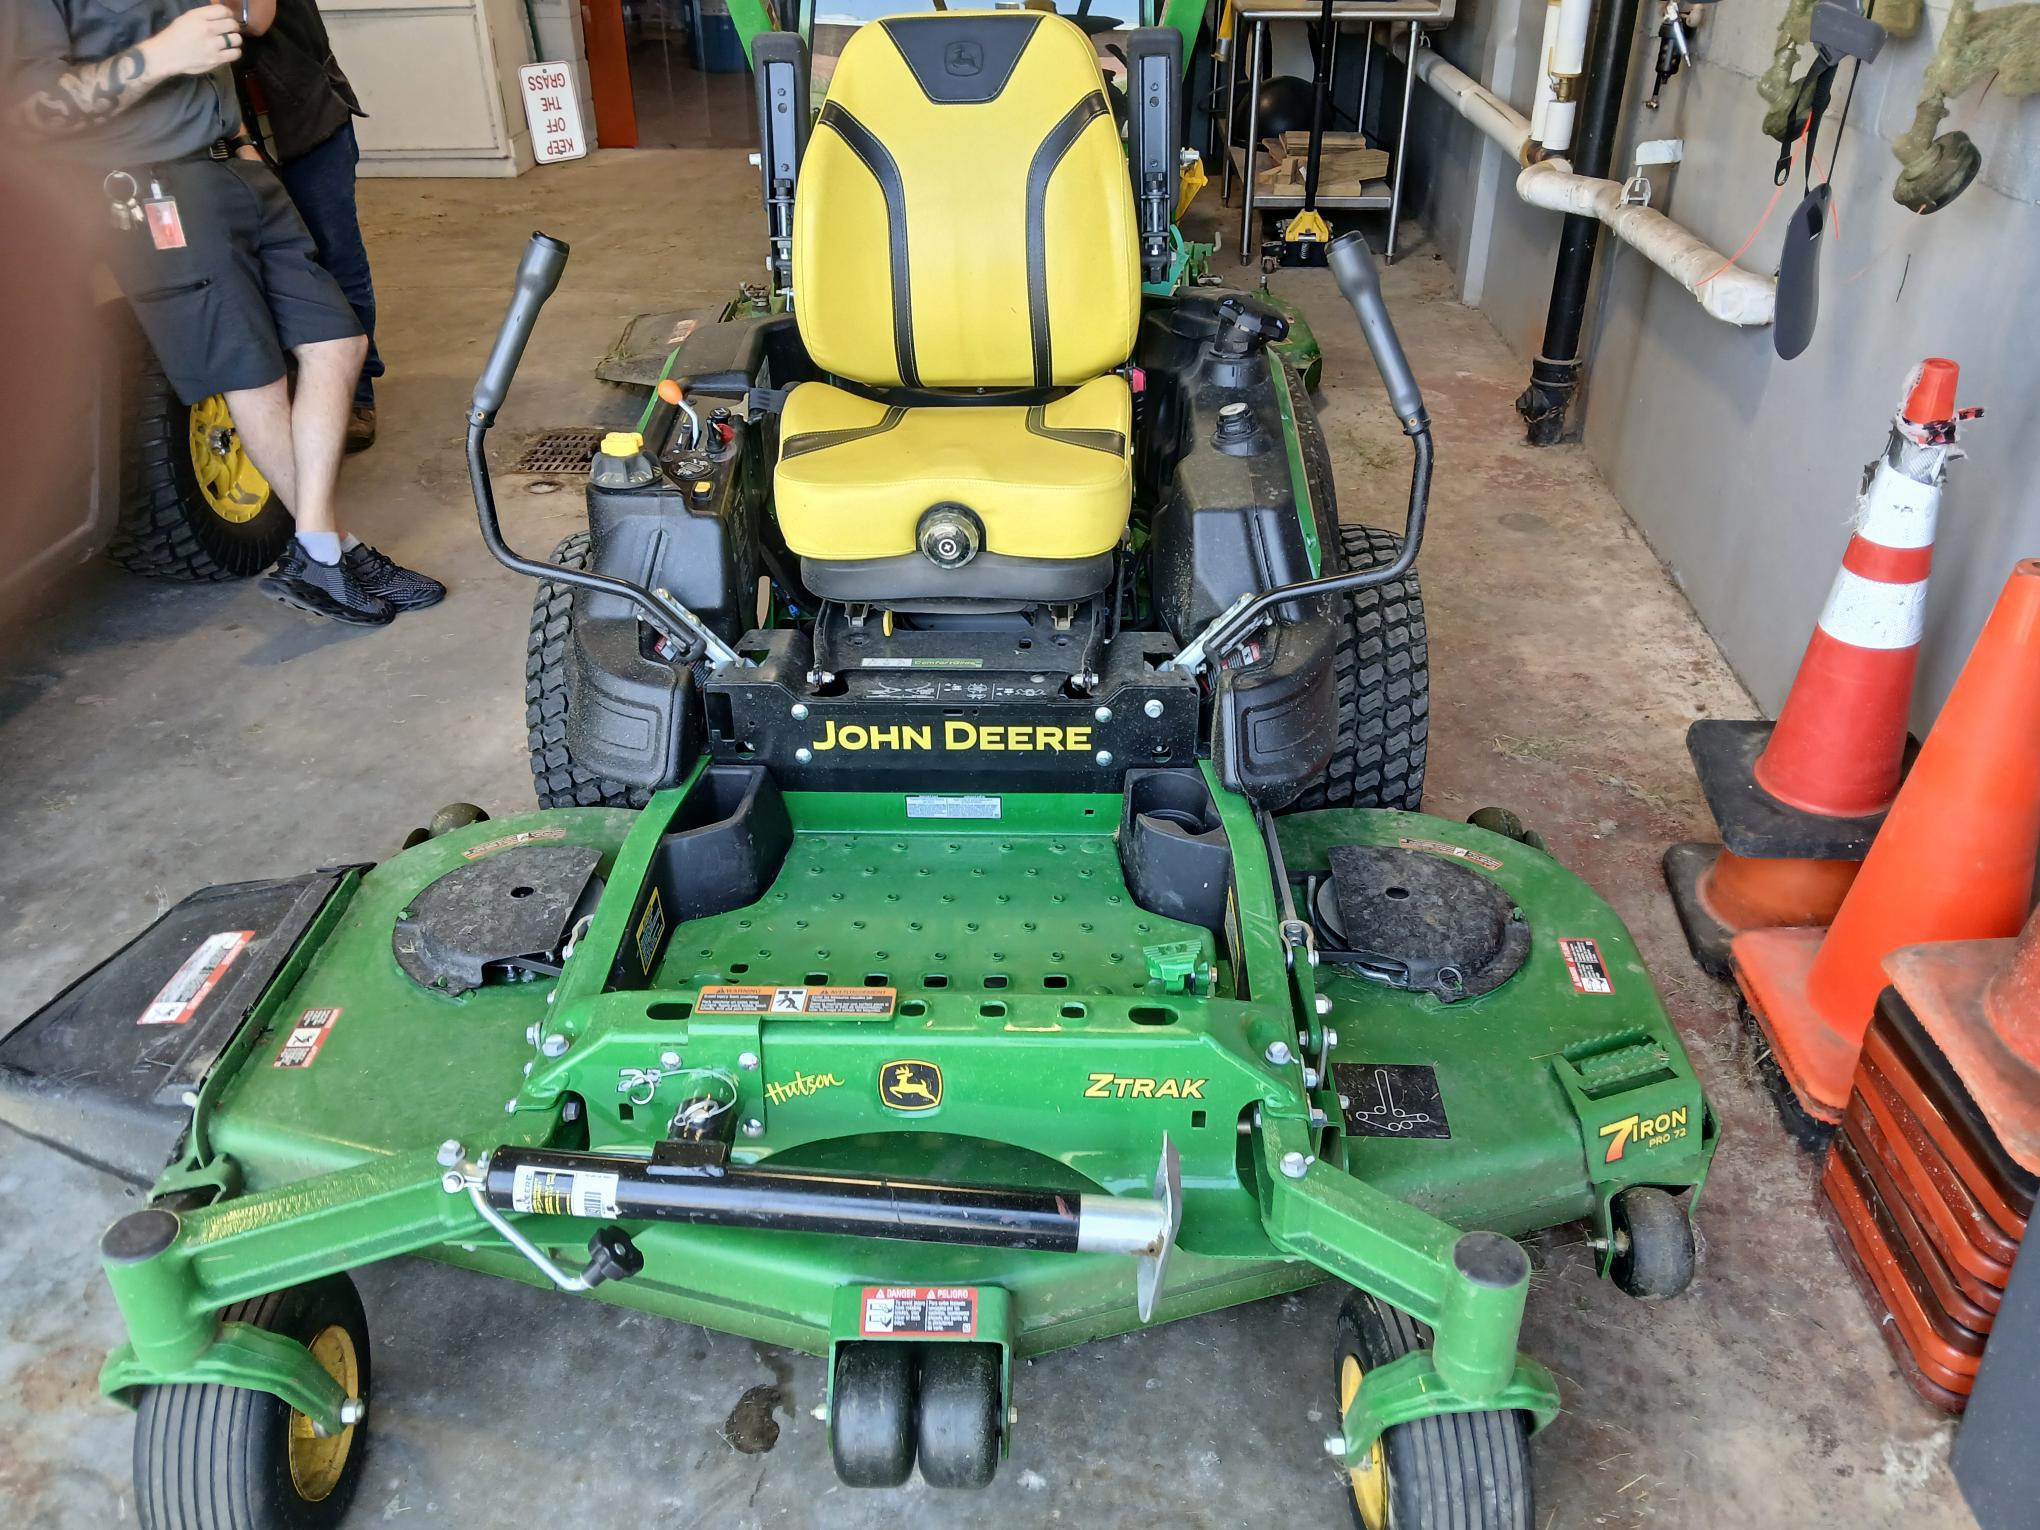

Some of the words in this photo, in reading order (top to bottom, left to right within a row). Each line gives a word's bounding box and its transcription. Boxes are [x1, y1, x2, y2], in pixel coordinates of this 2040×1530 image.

[528, 73, 565, 91] GRASS
[540, 96, 562, 111] THE
[546, 117, 565, 133] OFF
[547, 138, 574, 155] KEEP
[813, 720, 932, 750] JOHN
[944, 720, 1092, 751] DEERE
[764, 1071, 845, 1105] Hutson
[1084, 1072, 1208, 1099] ZTRAK
[1648, 1133, 1671, 1148] PRO
[1673, 1127, 1687, 1139] 72
[886, 1289, 917, 1298] DANGER
[937, 1289, 969, 1299] PELIGRO
